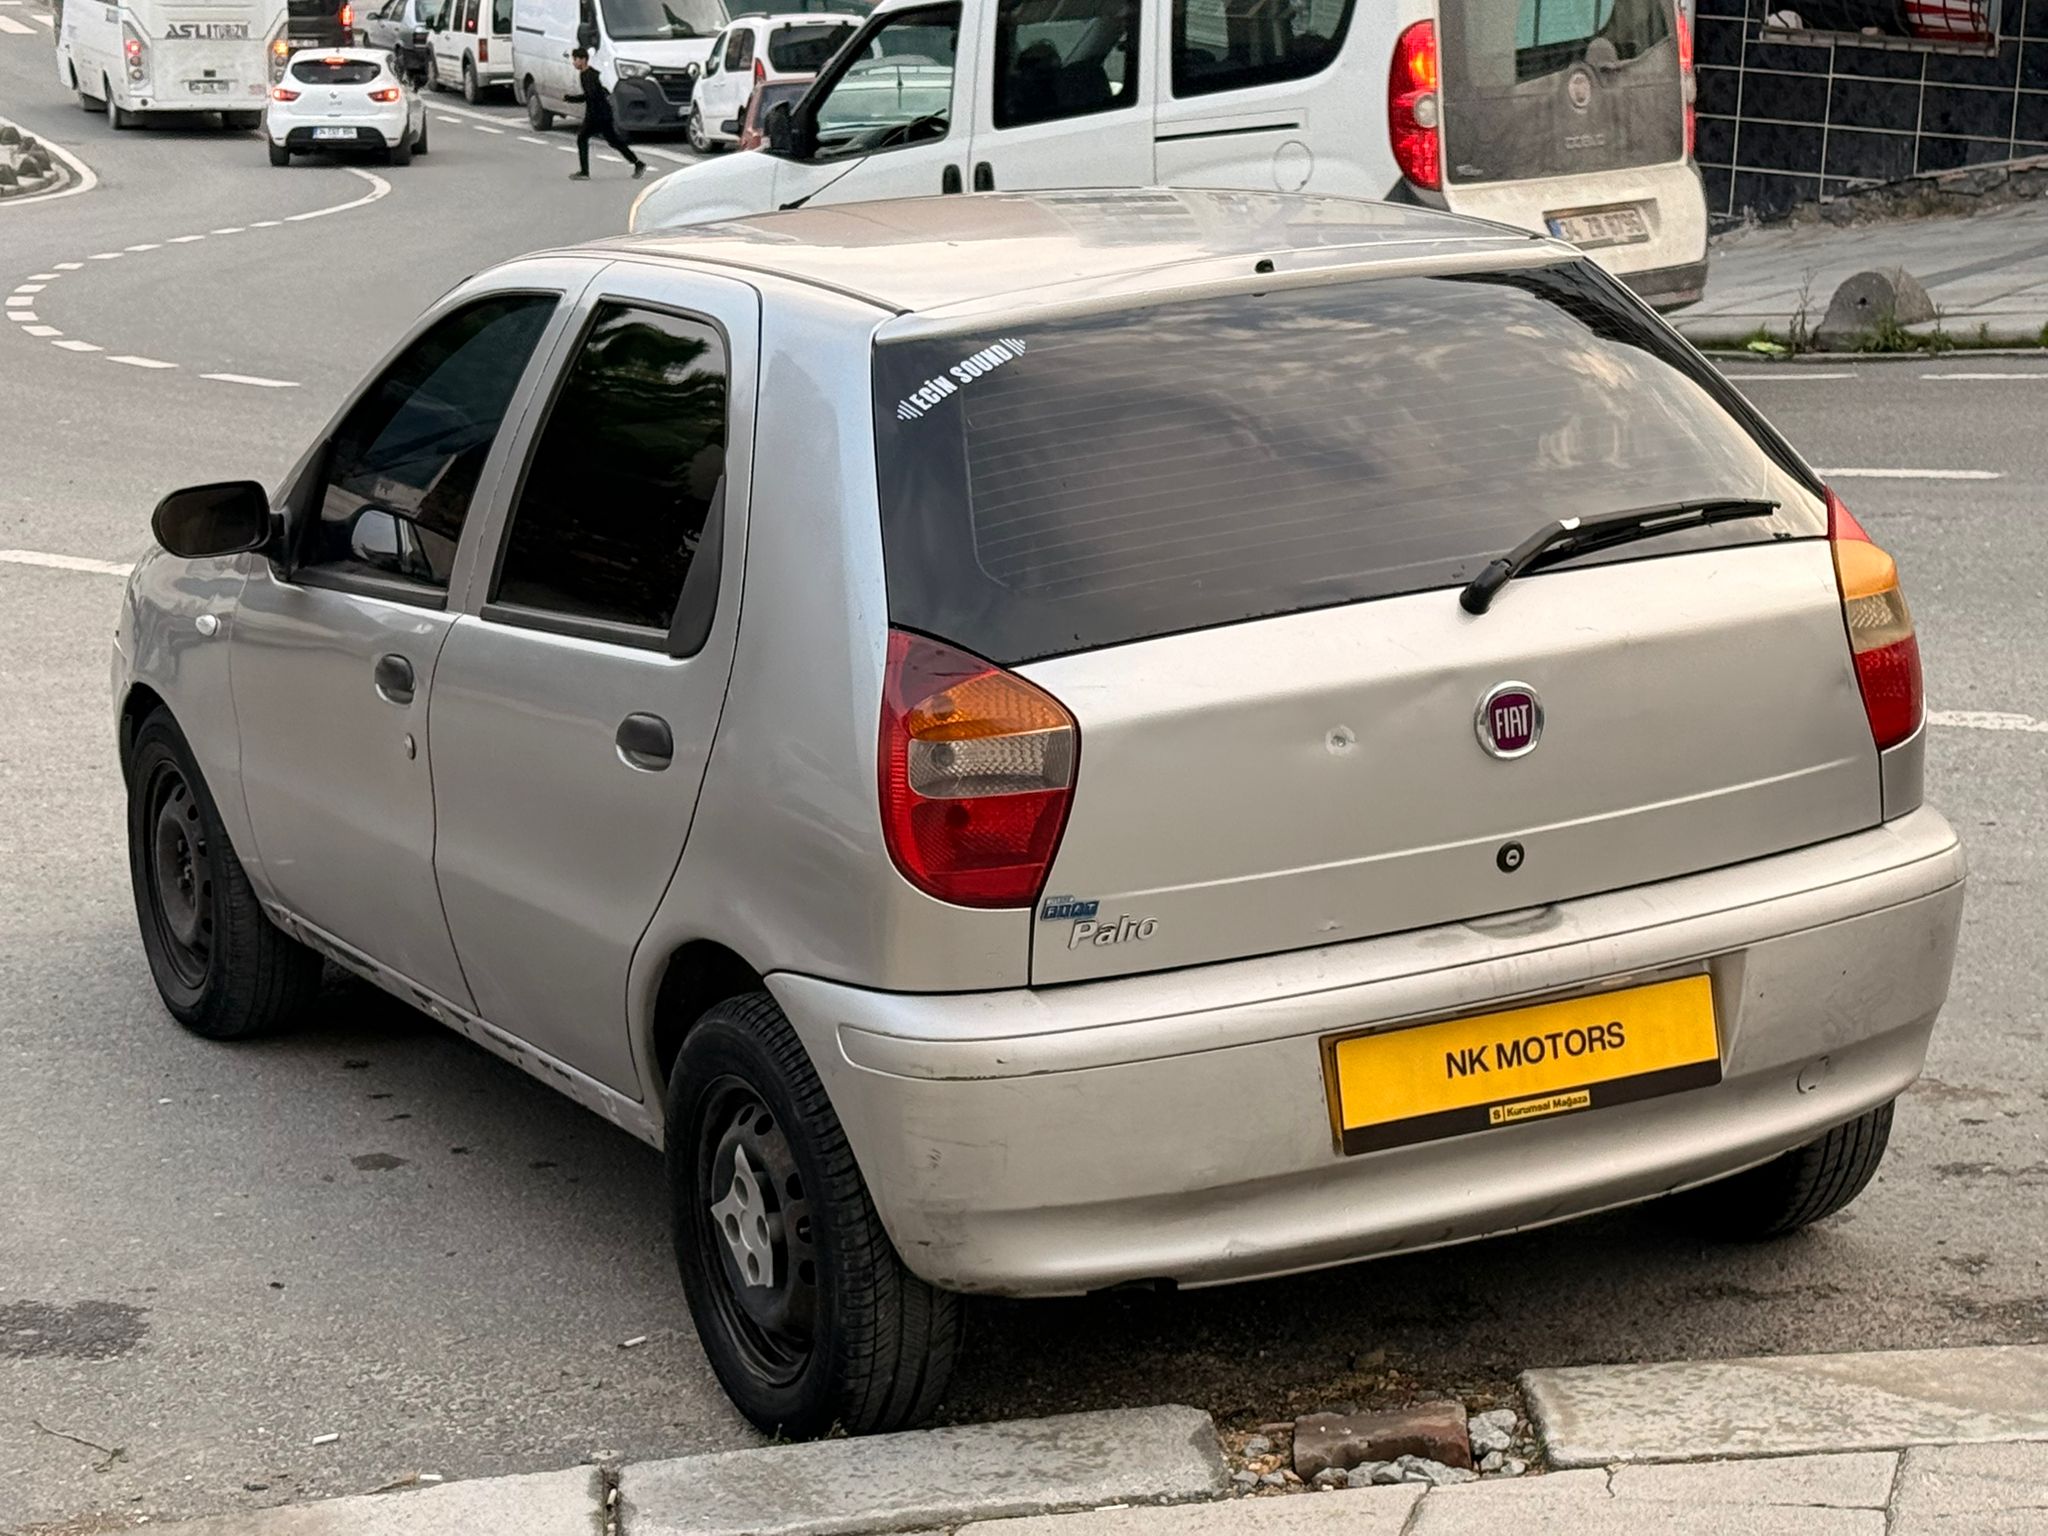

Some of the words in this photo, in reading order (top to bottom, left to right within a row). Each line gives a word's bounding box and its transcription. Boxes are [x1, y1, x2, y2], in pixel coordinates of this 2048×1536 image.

[949, 344, 1013, 383] SOUND
[1495, 704, 1529, 740] FIAT
[1045, 902, 1097, 918] FIAT
[1446, 1046, 1490, 1079] NK
[1496, 1021, 1626, 1070] MOTORS
[1506, 1101, 1551, 1117] Kurumsal
[1552, 1095, 1588, 1109] Mağaza
